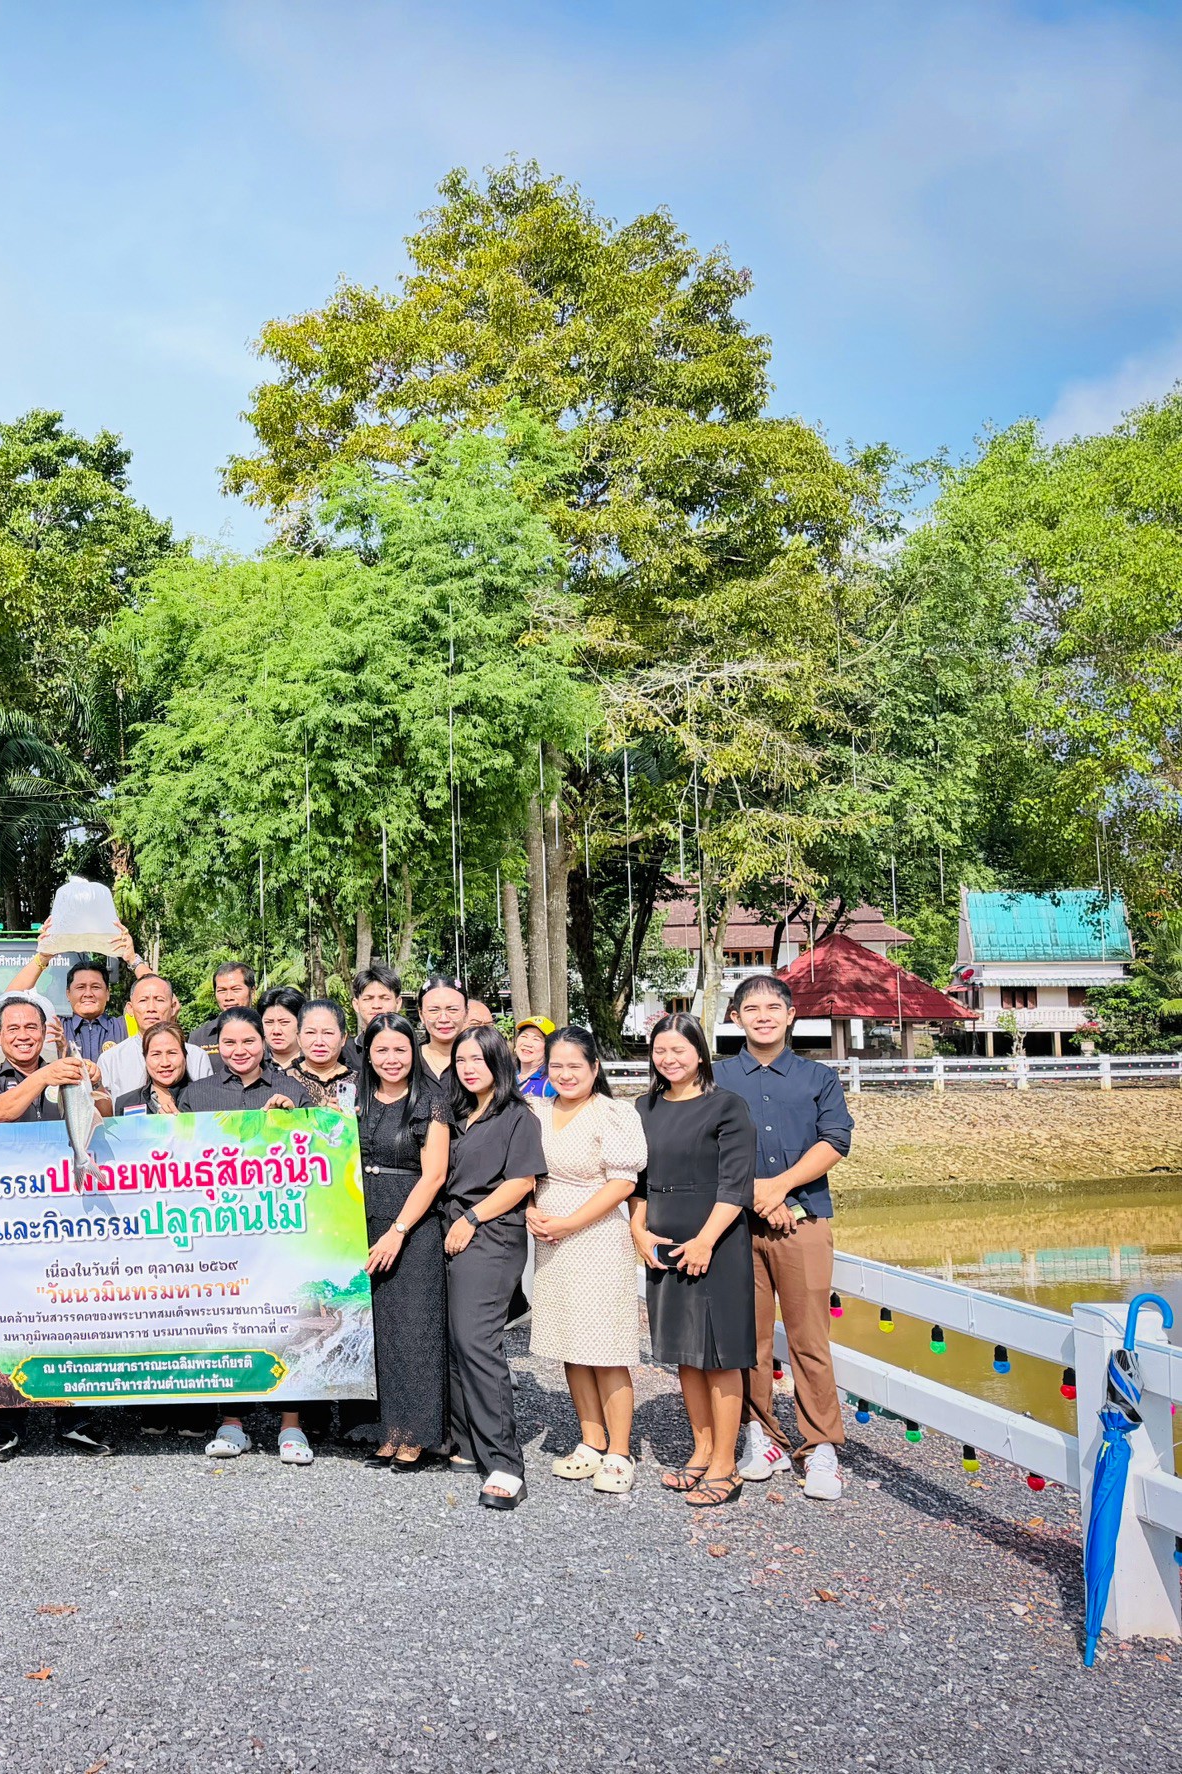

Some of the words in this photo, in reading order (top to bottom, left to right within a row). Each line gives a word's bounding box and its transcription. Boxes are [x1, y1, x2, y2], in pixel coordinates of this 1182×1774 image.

[45, 1257, 120, 1278] เนื่องในวันที่
[124, 1265, 143, 1276] ๑๓
[148, 1263, 194, 1279] ตุลาคม
[36, 1278, 249, 1304] "วันนวมินทรมหาราช"
[3, 1329, 149, 1345] มหาภูมิพลอดุลยเดชมหาราช
[153, 1323, 228, 1338] บรมนาถบพิตร
[232, 1319, 276, 1334] รัชกาลที่
[280, 1324, 289, 1334] ๙
[43, 1363, 55, 1374] ณ
[58, 1354, 253, 1374] บริเวณสวนสาธารณะเฉลิมพระเกียรติ
[64, 1373, 234, 1393] องค์การบริหารส่วนตำบลท่าข้าม
